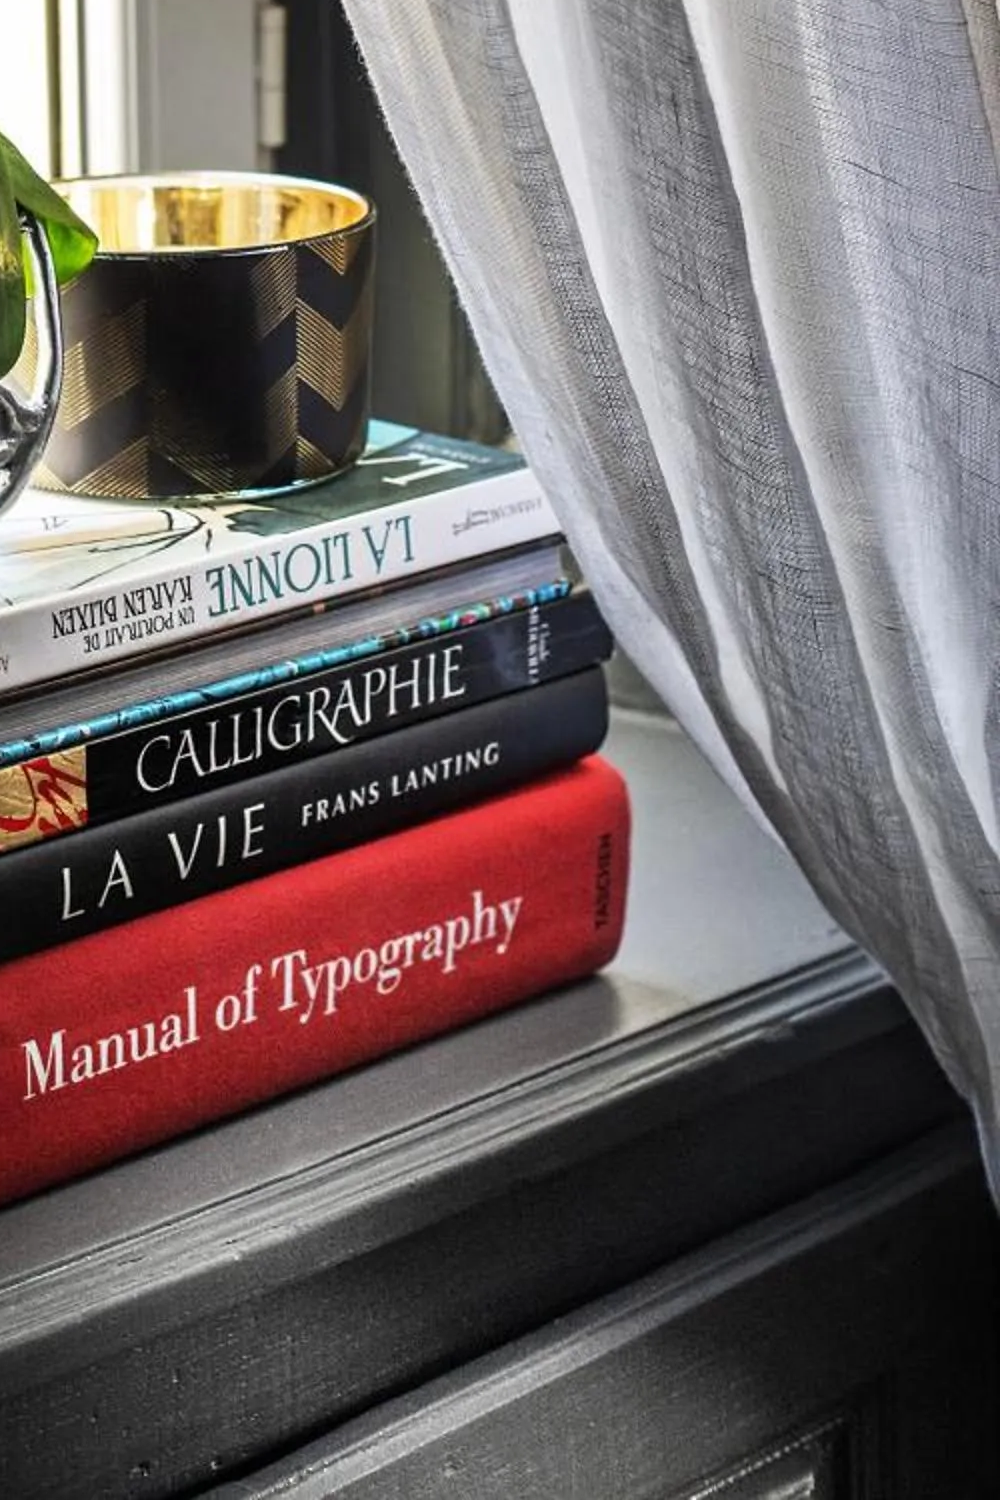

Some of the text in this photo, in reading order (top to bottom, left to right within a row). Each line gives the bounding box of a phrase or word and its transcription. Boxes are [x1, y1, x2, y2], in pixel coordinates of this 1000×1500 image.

[51, 575, 193, 640] KAREN BLIXEN
[83, 605, 195, 654] UN PORTRAIT DE
[206, 514, 415, 618] LA LIONNE
[135, 643, 466, 794] CALLIGRAPHIE
[60, 741, 501, 921] LA VIE FRANS LANTING
[21, 888, 524, 1102] Manual of Typography
